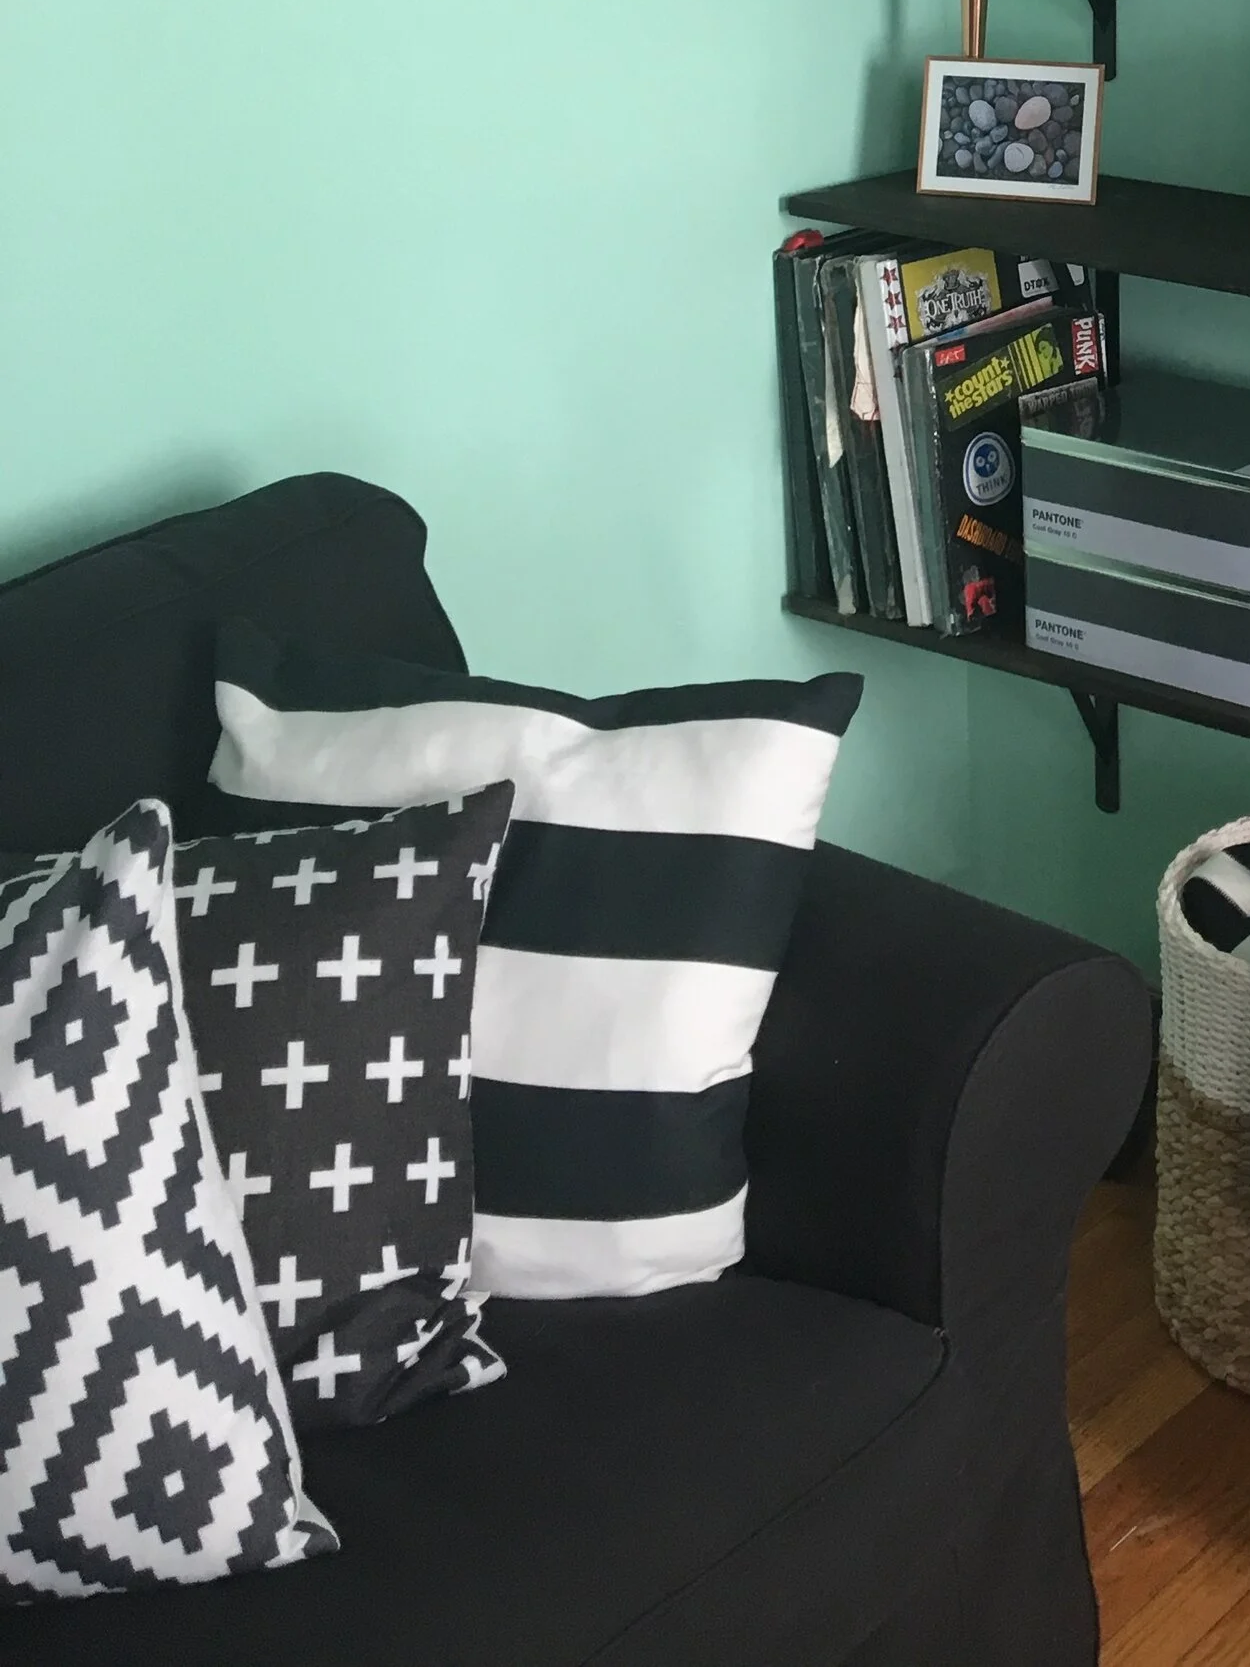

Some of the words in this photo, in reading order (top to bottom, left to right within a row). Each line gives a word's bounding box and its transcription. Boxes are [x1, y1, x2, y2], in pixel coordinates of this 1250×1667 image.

[926, 300, 949, 317] ONE
[948, 289, 983, 310] TRUTH
[954, 356, 1001, 399] count
[949, 396, 975, 419] the
[973, 369, 1013, 407] stars
[975, 473, 1006, 496] THINK
[1032, 508, 1083, 530] PANTONE
[1035, 618, 1085, 641] PANTONE
